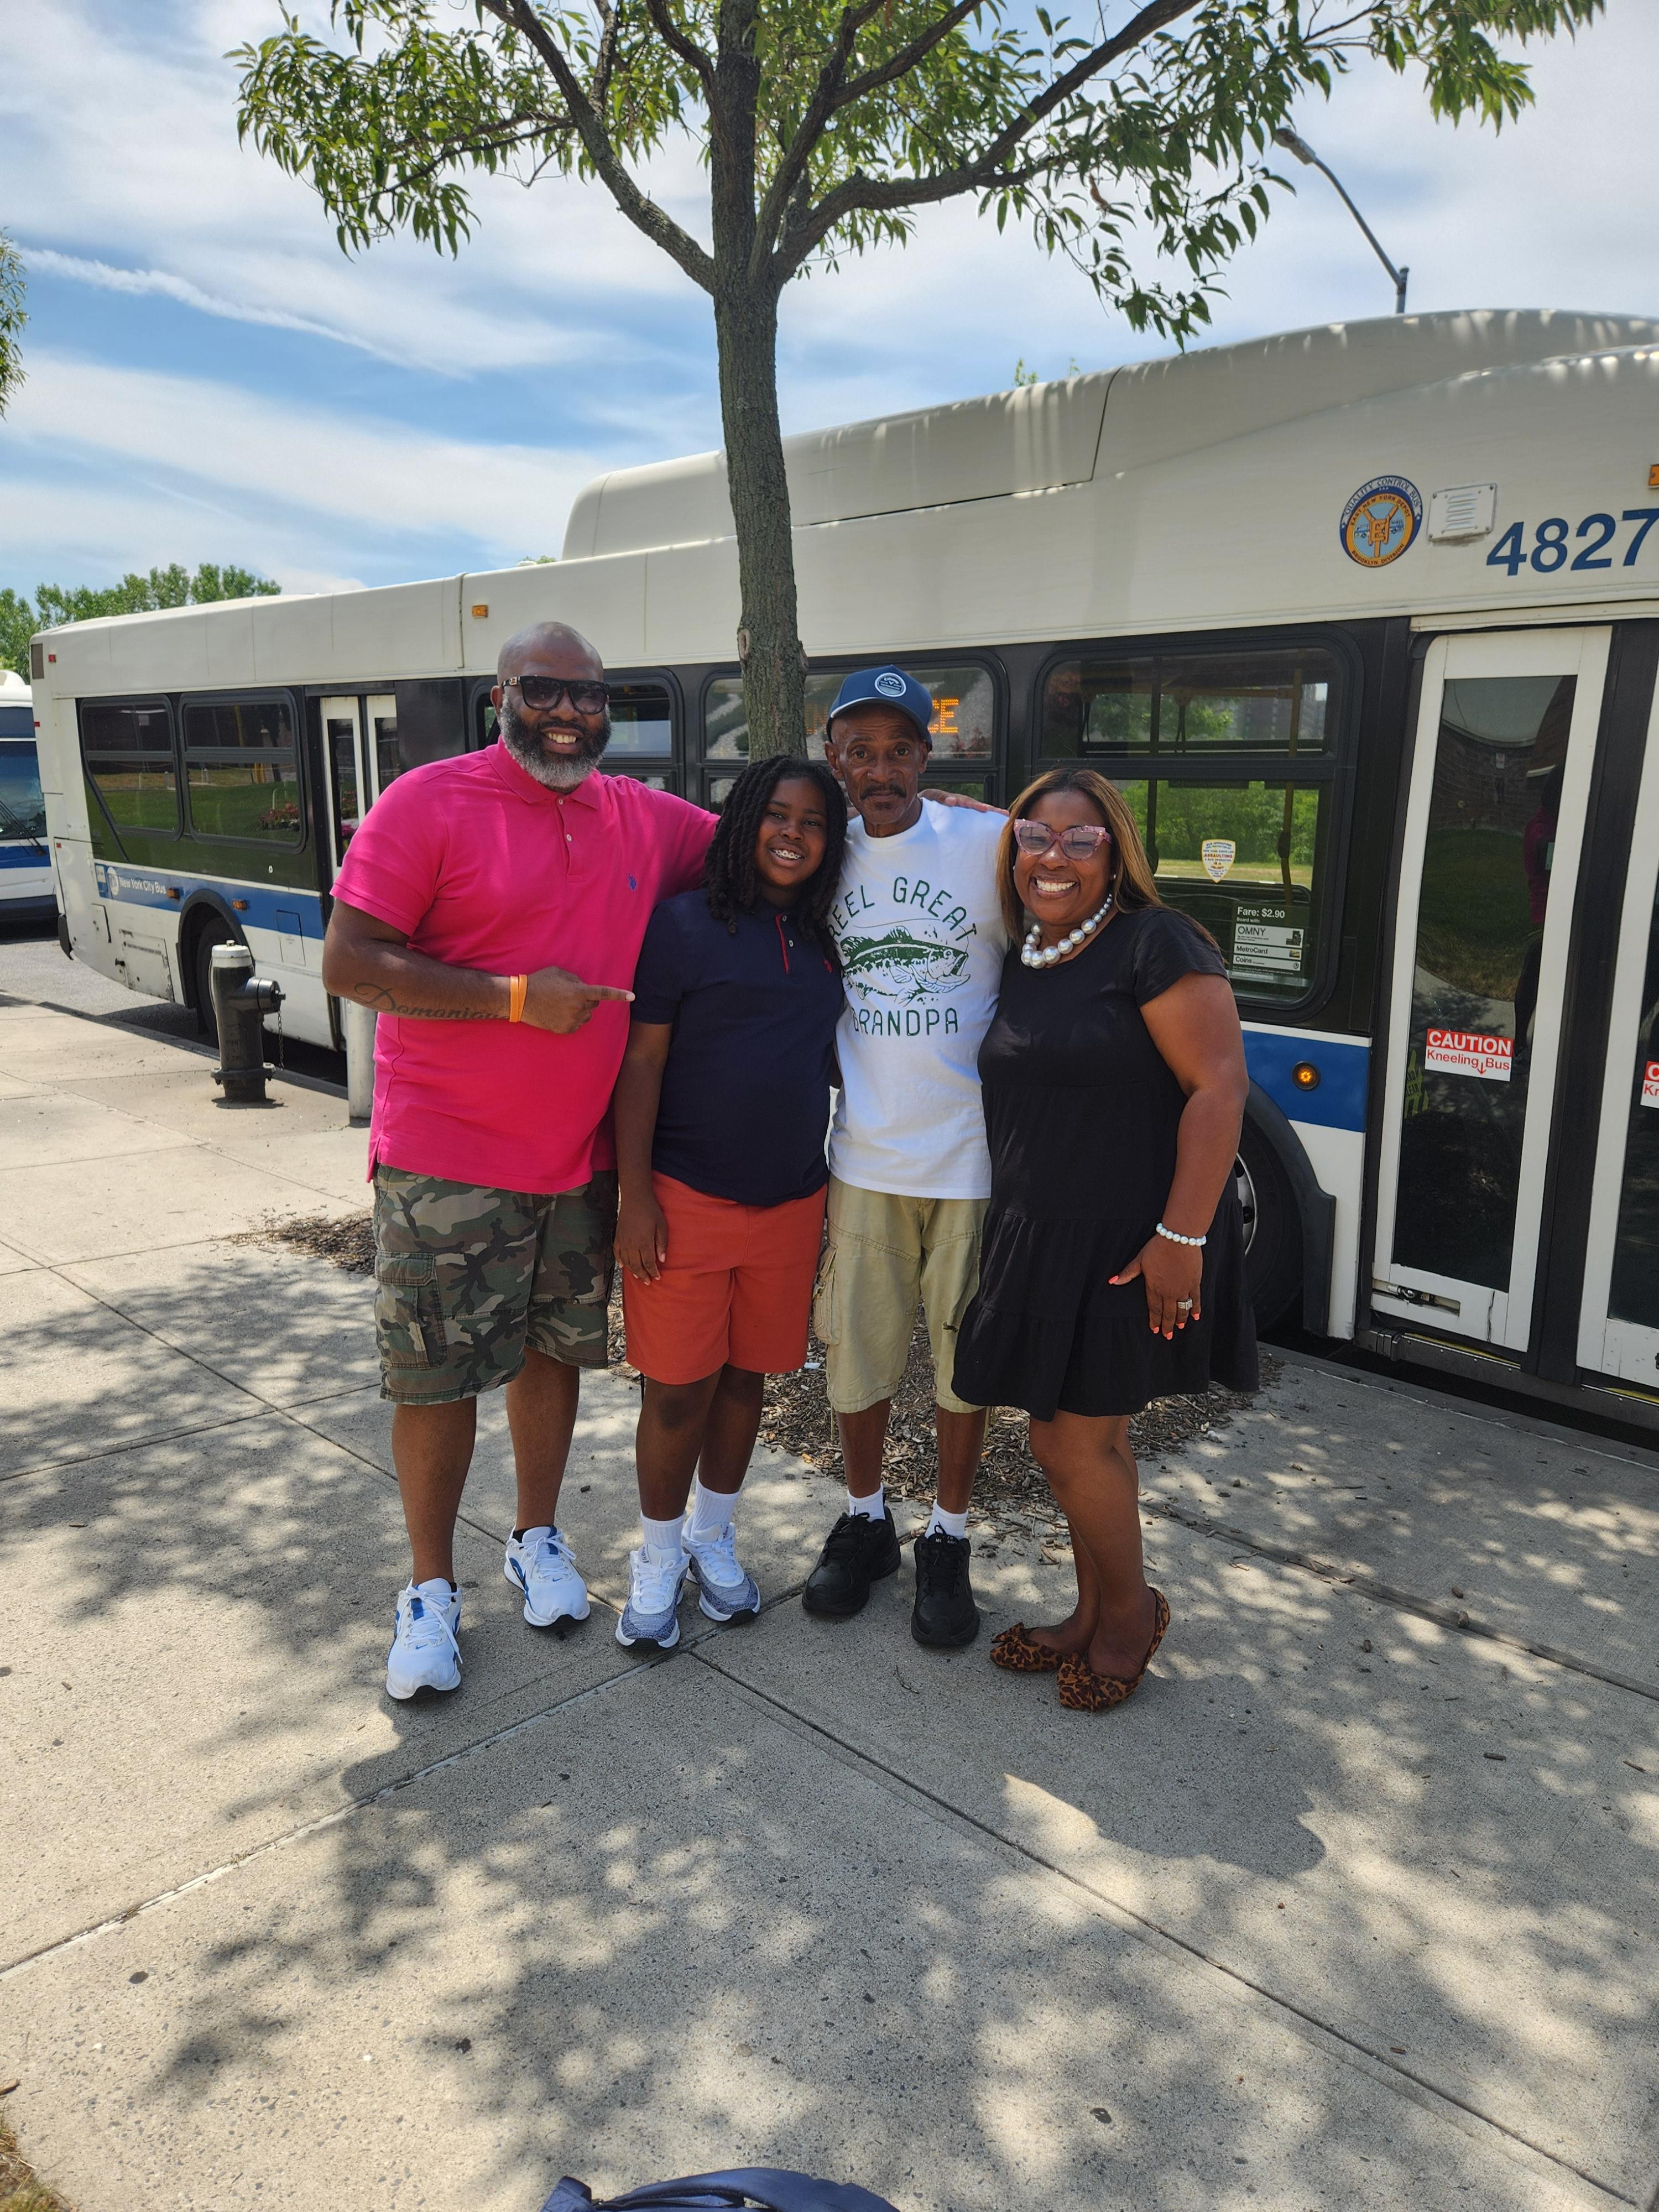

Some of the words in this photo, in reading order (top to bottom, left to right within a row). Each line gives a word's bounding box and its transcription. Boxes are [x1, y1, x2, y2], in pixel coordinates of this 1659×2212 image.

[1344, 483, 1373, 515] QUALITY
[1378, 477, 1411, 492] CONTROL
[1410, 491, 1420, 507] BUS
[1350, 509, 1362, 525] EAST
[1363, 498, 1376, 508] NEW
[1397, 499, 1411, 517] DEPOT
[1486, 508, 1659, 576] 4827
[1352, 550, 1378, 565] BROOKLYN
[1381, 544, 1405, 564] DIVISION
[119, 876, 131, 888] New
[131, 878, 143, 890] York
[144, 880, 154, 894] City
[155, 881, 166, 894] Bus
[893, 877, 977, 941] GREAT
[1237, 907, 1259, 916] Fare:
[1261, 908, 1285, 918] $2.90
[1238, 926, 1266, 936] OMNY
[1236, 946, 1268, 954] MetroCard
[851, 1006, 958, 1036] GRANDPA
[1429, 1031, 1511, 1056] CAUTION
[1427, 1050, 1479, 1068] Kneeling
[1486, 1057, 1510, 1071] Bus
